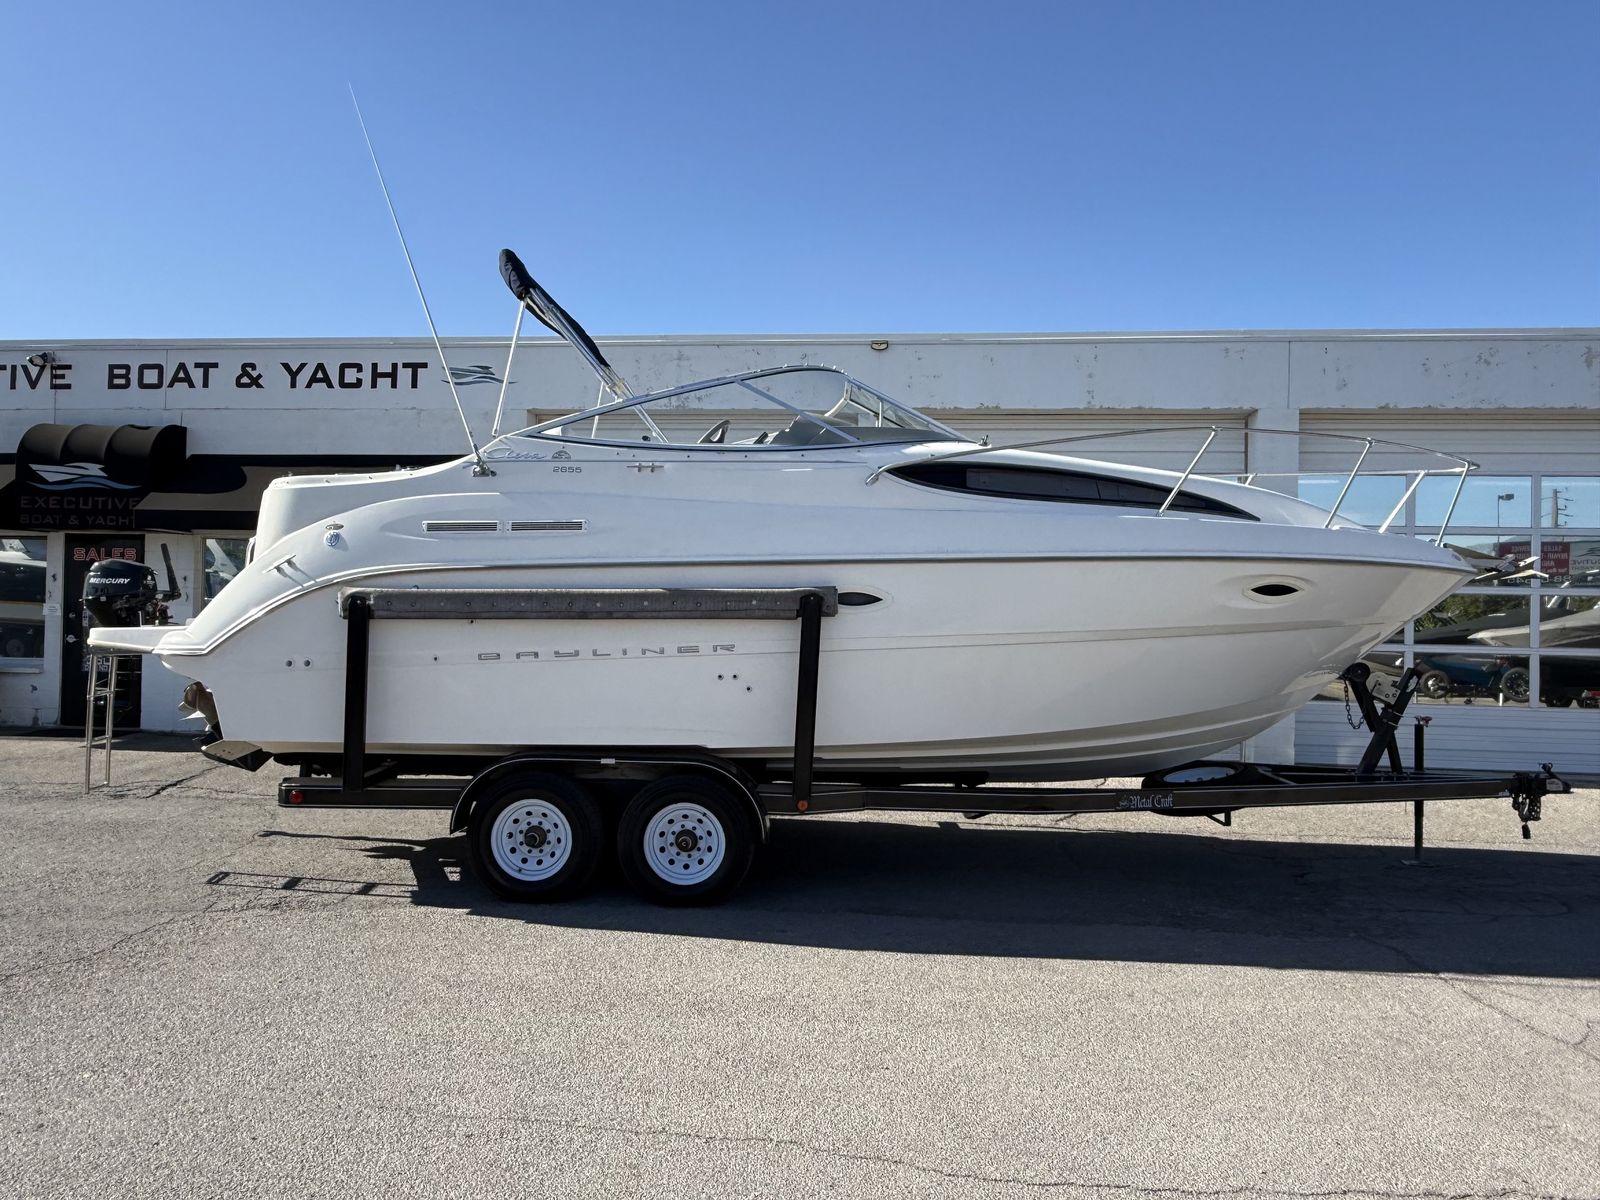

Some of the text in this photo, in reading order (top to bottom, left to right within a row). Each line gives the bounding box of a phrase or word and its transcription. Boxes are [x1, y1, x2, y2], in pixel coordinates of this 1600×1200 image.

[0, 362, 429, 390] IVE BOAT & YACHT
[20, 496, 141, 510] EXECUTIVE
[19, 514, 62, 525] BOAT
[68, 516, 80, 526] &
[73, 547, 137, 561] SALES
[477, 643, 736, 661] BAYLINER
[1129, 793, 1174, 809] Metal Craft
